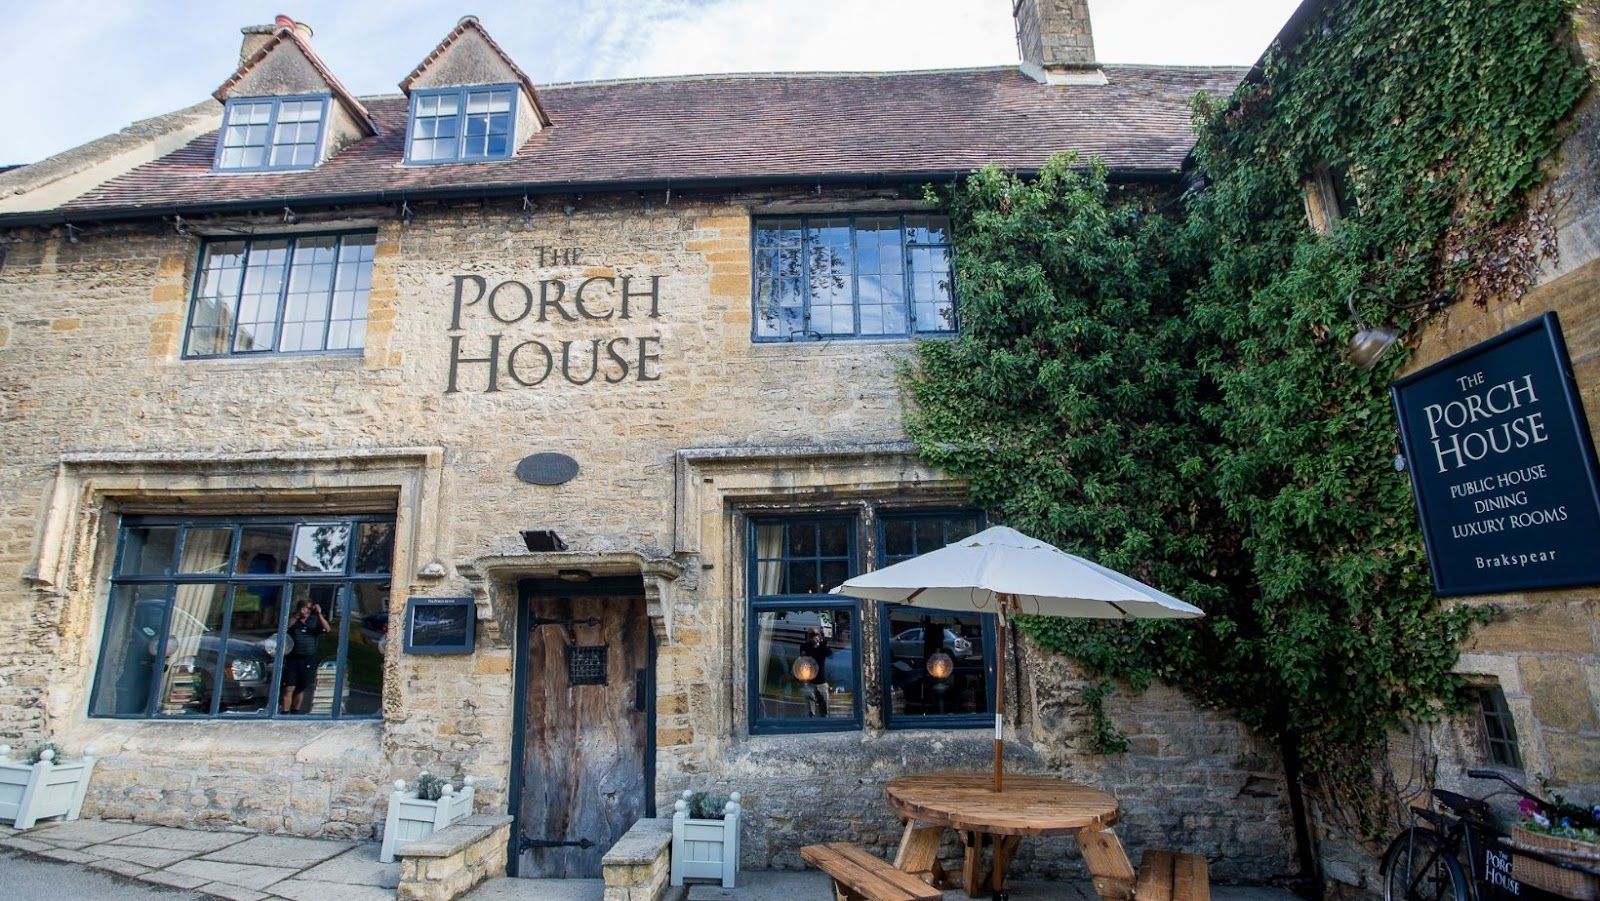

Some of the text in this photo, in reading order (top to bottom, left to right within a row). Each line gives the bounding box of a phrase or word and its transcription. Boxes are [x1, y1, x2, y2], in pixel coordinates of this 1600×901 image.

[533, 245, 585, 268] THE
[447, 274, 662, 331] PORCH
[444, 334, 661, 394] HOUSE
[1457, 371, 1485, 392] THE
[1423, 374, 1539, 440] PORCH
[1431, 412, 1548, 473] HOUSE
[1450, 464, 1547, 498] PUBLIC HOUSE
[1474, 491, 1528, 514] DINING
[1452, 506, 1568, 539] LUXURY ROOMS
[1475, 550, 1557, 569] Brakspear
[1486, 849, 1513, 875] PORC
[1485, 864, 1520, 896] HOUSE
